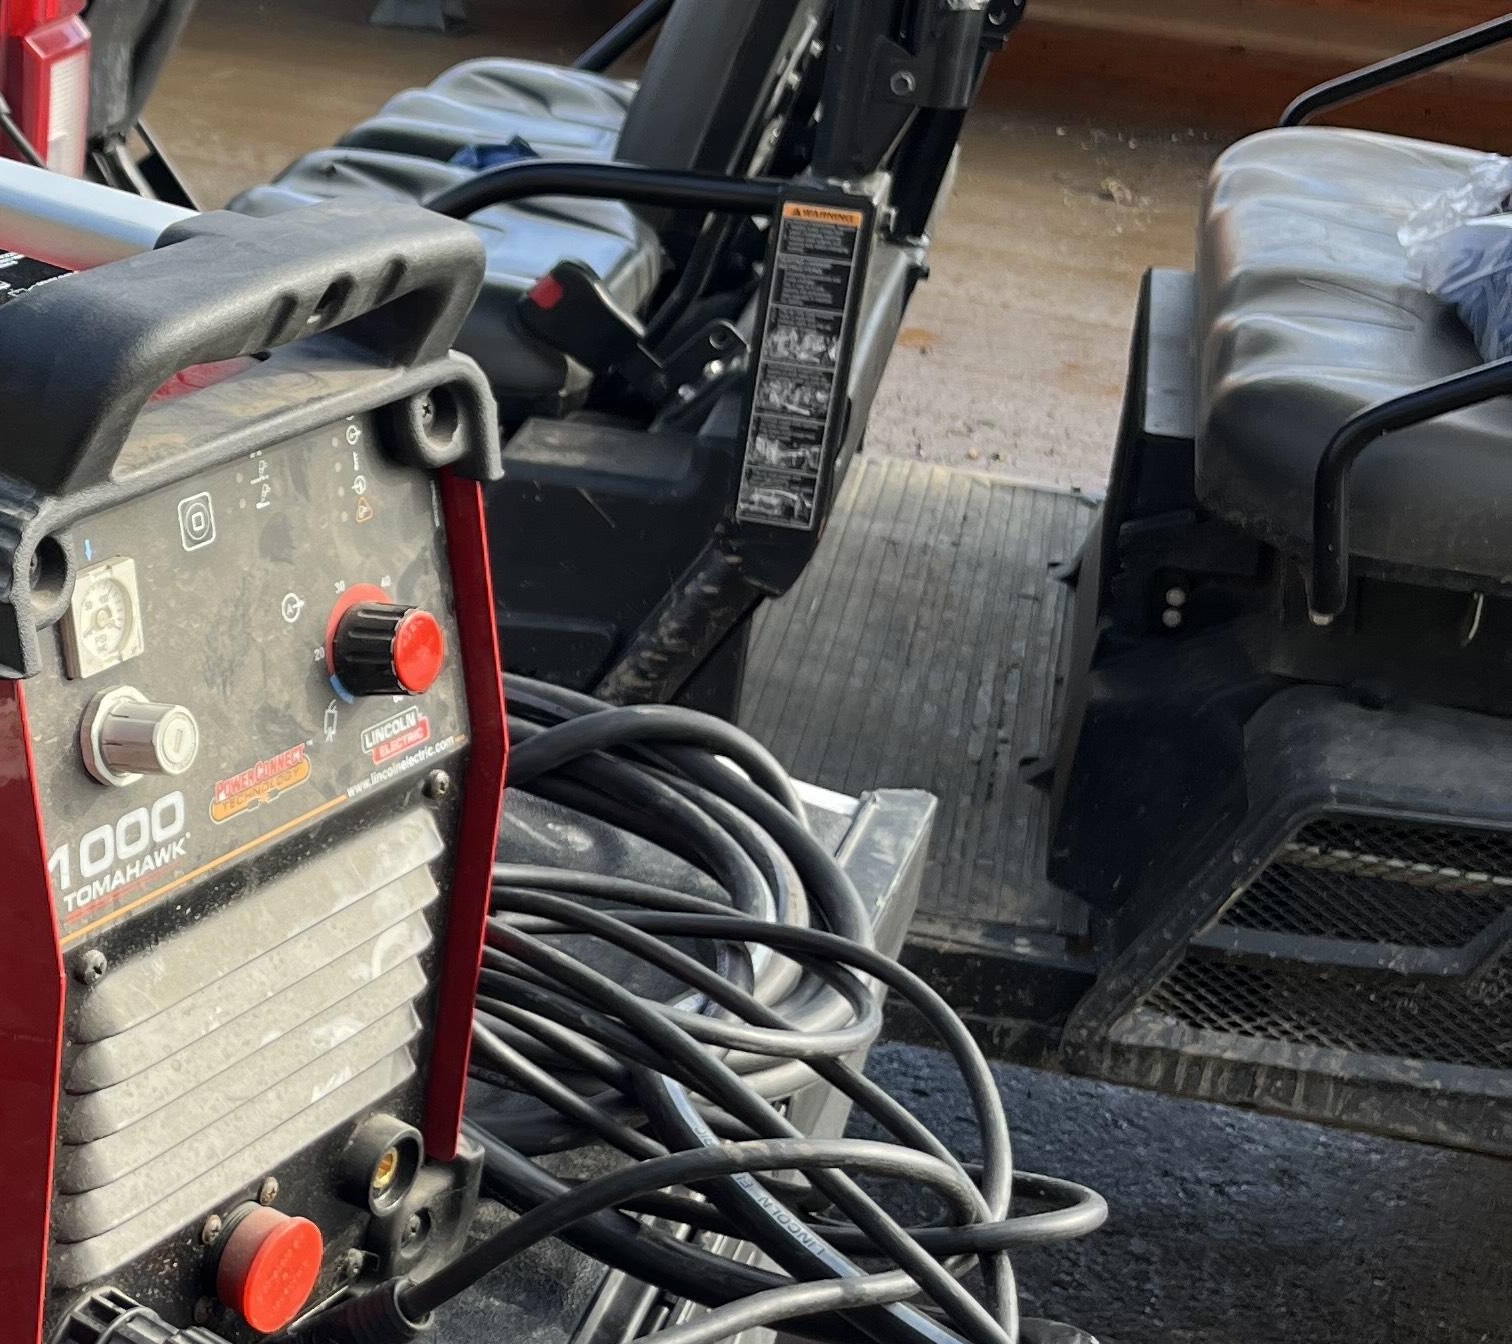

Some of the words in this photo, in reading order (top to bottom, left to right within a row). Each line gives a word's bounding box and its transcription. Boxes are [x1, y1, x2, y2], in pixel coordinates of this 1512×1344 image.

[363, 711, 418, 749] LINCOLN
[346, 735, 455, 798] www.lincolnelectric.com
[48, 790, 185, 891] 1000
[63, 836, 187, 913] TOMAHAWK
[757, 1196, 826, 1256] LINCOLN
